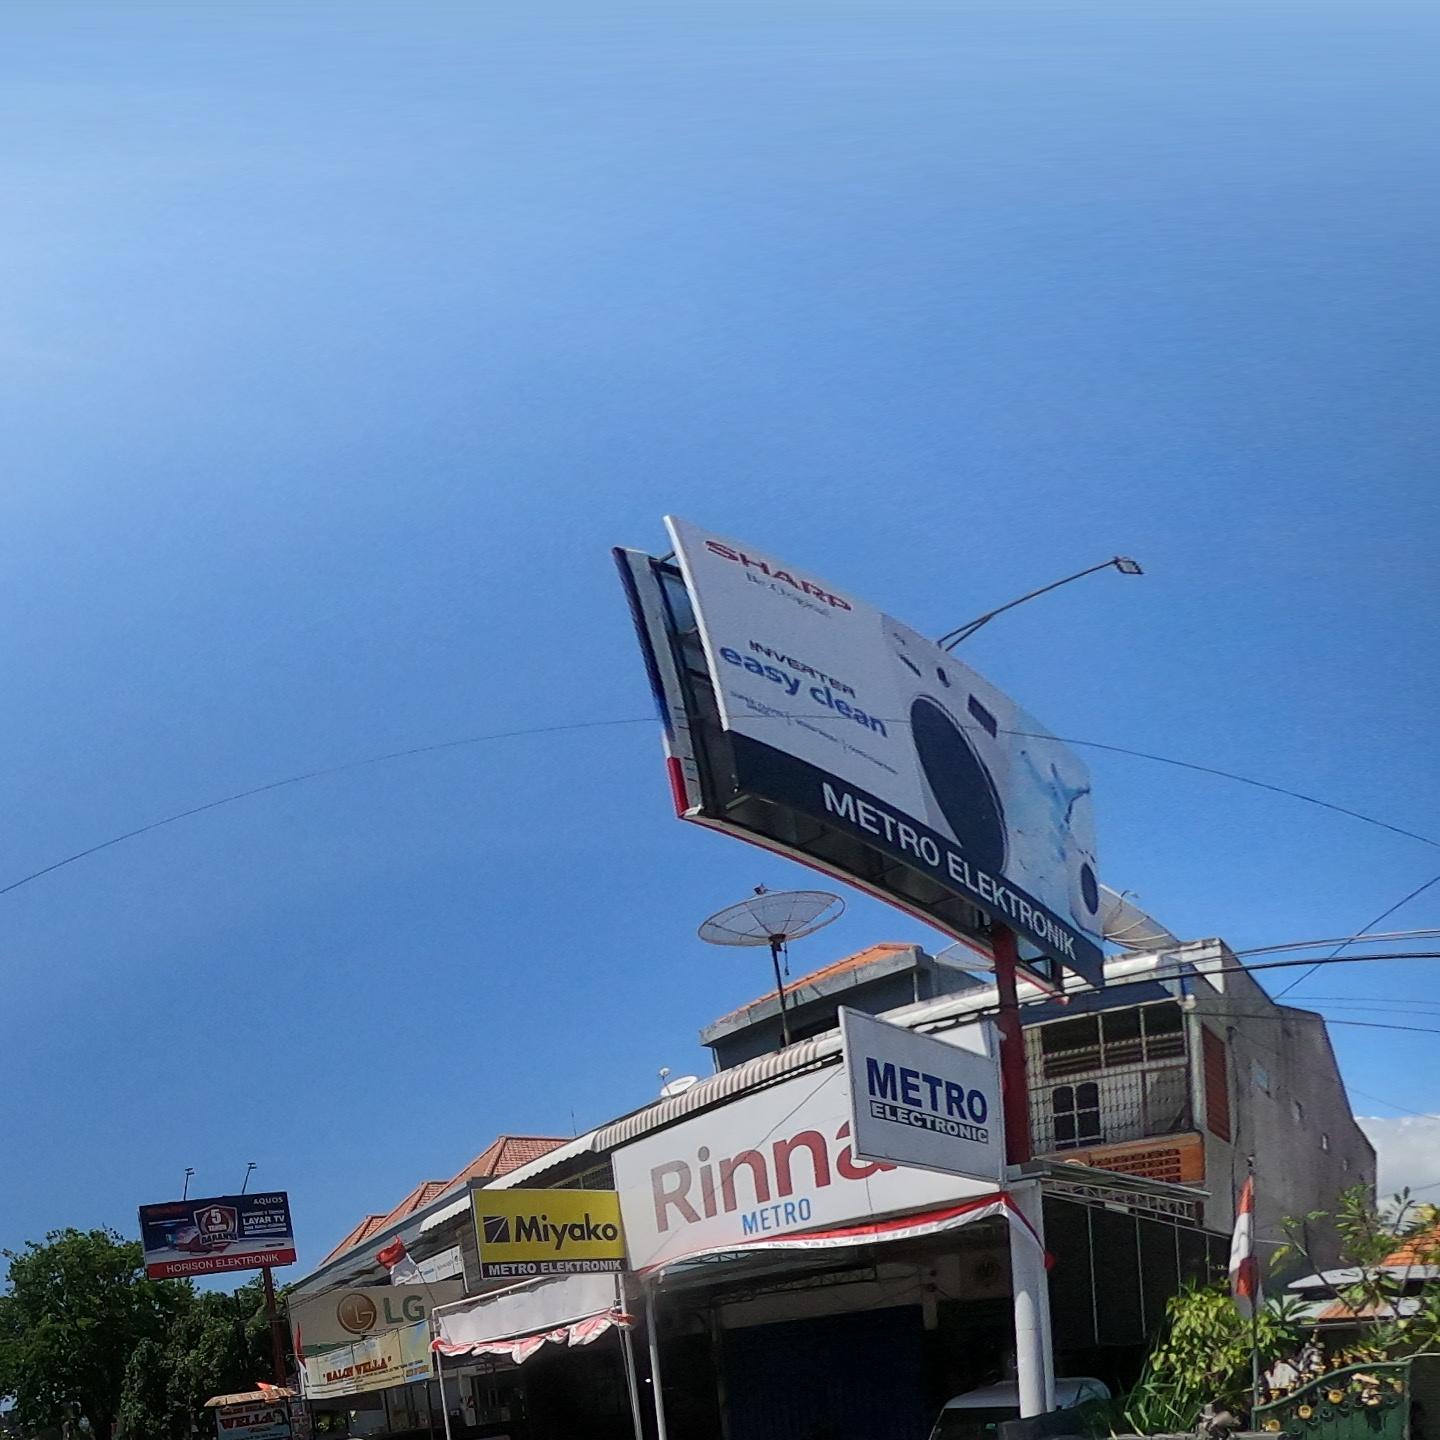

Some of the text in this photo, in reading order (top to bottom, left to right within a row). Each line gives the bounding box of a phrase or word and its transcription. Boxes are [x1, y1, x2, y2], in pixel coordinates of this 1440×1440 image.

[705, 540, 852, 611] SHARP
[749, 639, 856, 698] INVERTER
[719, 647, 800, 696] easy
[810, 686, 888, 738] clean
[822, 782, 1077, 960] METRO ELEKTRONIK
[866, 1057, 989, 1125] METRO
[870, 1099, 989, 1144] ELECTRONIC
[211, 1208, 221, 1224] 5
[243, 1214, 286, 1225] LAYAR TV
[253, 1196, 284, 1206] AQUOS
[741, 1198, 812, 1236] METRO
[515, 1213, 619, 1250] Miyako
[166, 1254, 279, 1274] HORISON ELEKTRONIK
[488, 1260, 622, 1276] METRO ELEKTRONIK
[383, 1295, 425, 1324] LG
